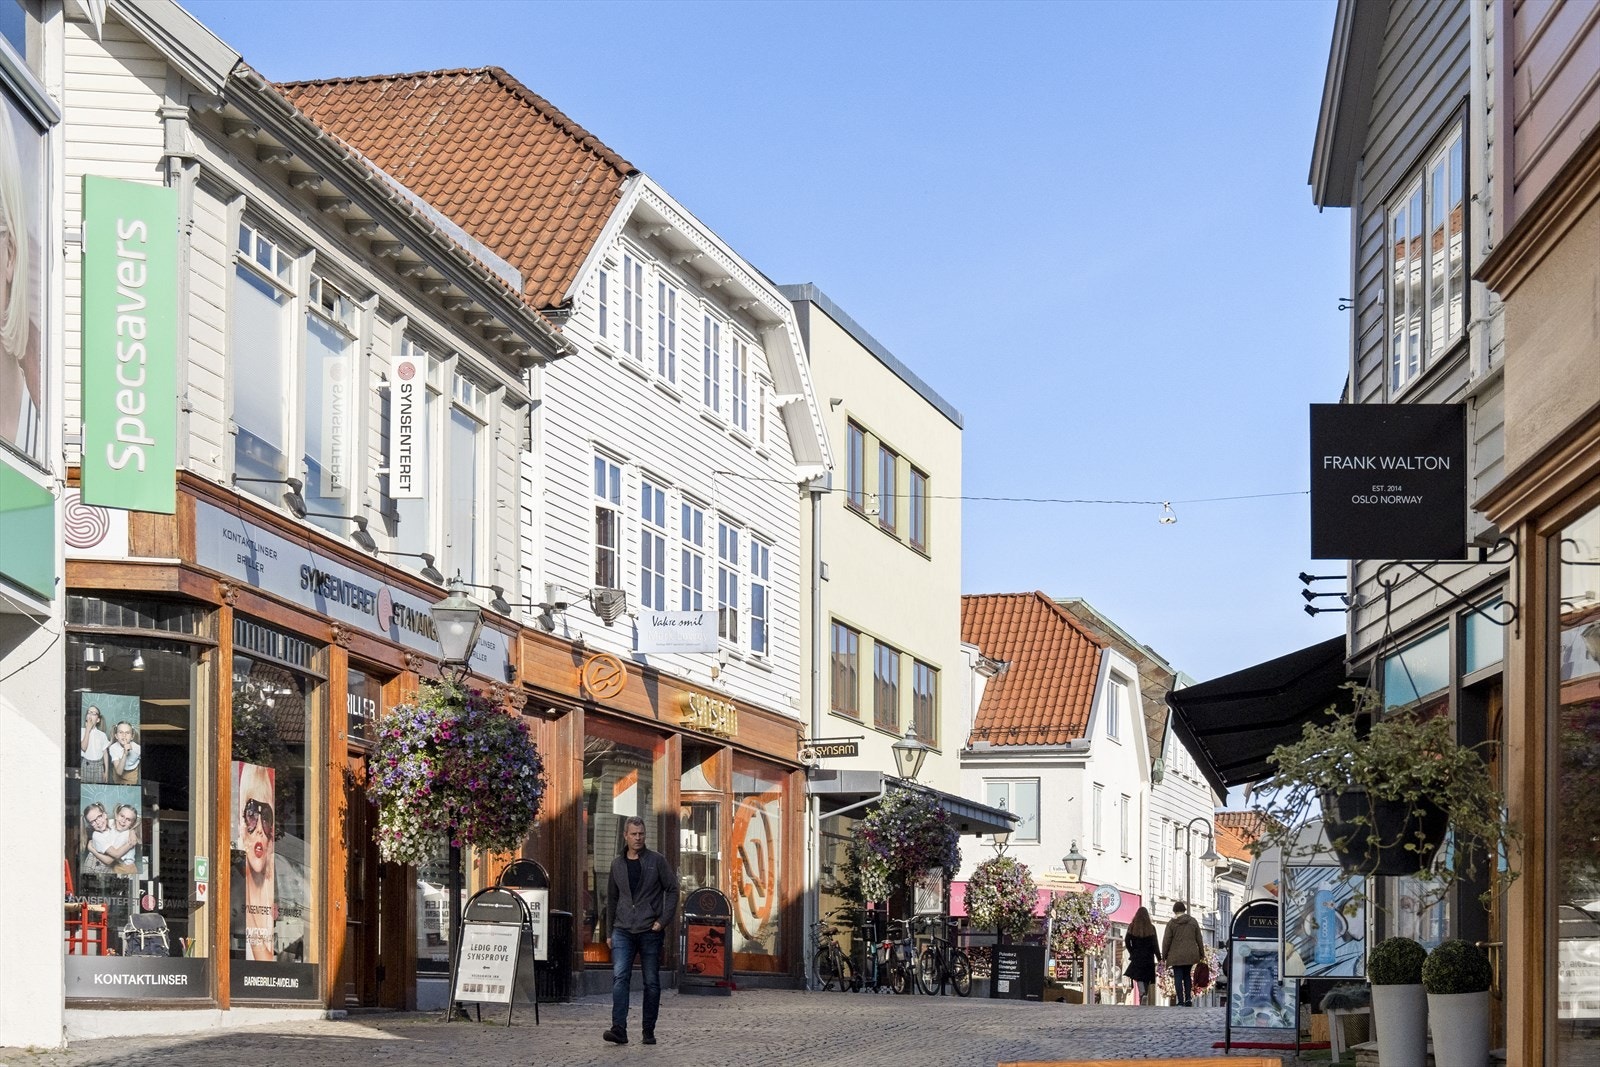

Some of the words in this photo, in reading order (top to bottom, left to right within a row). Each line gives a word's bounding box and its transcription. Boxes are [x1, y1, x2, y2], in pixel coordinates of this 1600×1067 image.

[106, 217, 155, 473] Specsavers
[399, 383, 412, 493] SYNSENTERET
[1323, 456, 1376, 470] FRANK
[1380, 456, 1450, 470] WALTON
[1351, 495, 1379, 504] OSLO
[1380, 495, 1423, 504] NORWAY
[222, 528, 278, 560] KONTAKTLINSER
[237, 553, 265, 573] BRILLER
[300, 563, 377, 616] SYNSENTERET
[392, 601, 439, 642] STAVANG
[652, 615, 676, 627] Vakre
[678, 613, 704, 627] smil
[815, 744, 855, 756] SYNSAM
[470, 944, 491, 952] LEDIG
[493, 945, 508, 953] FOR
[693, 942, 718, 954] 25%
[94, 974, 188, 985] KONTAKTLINSER
[244, 976, 299, 988] BARNEBRILLE-AVDELING
